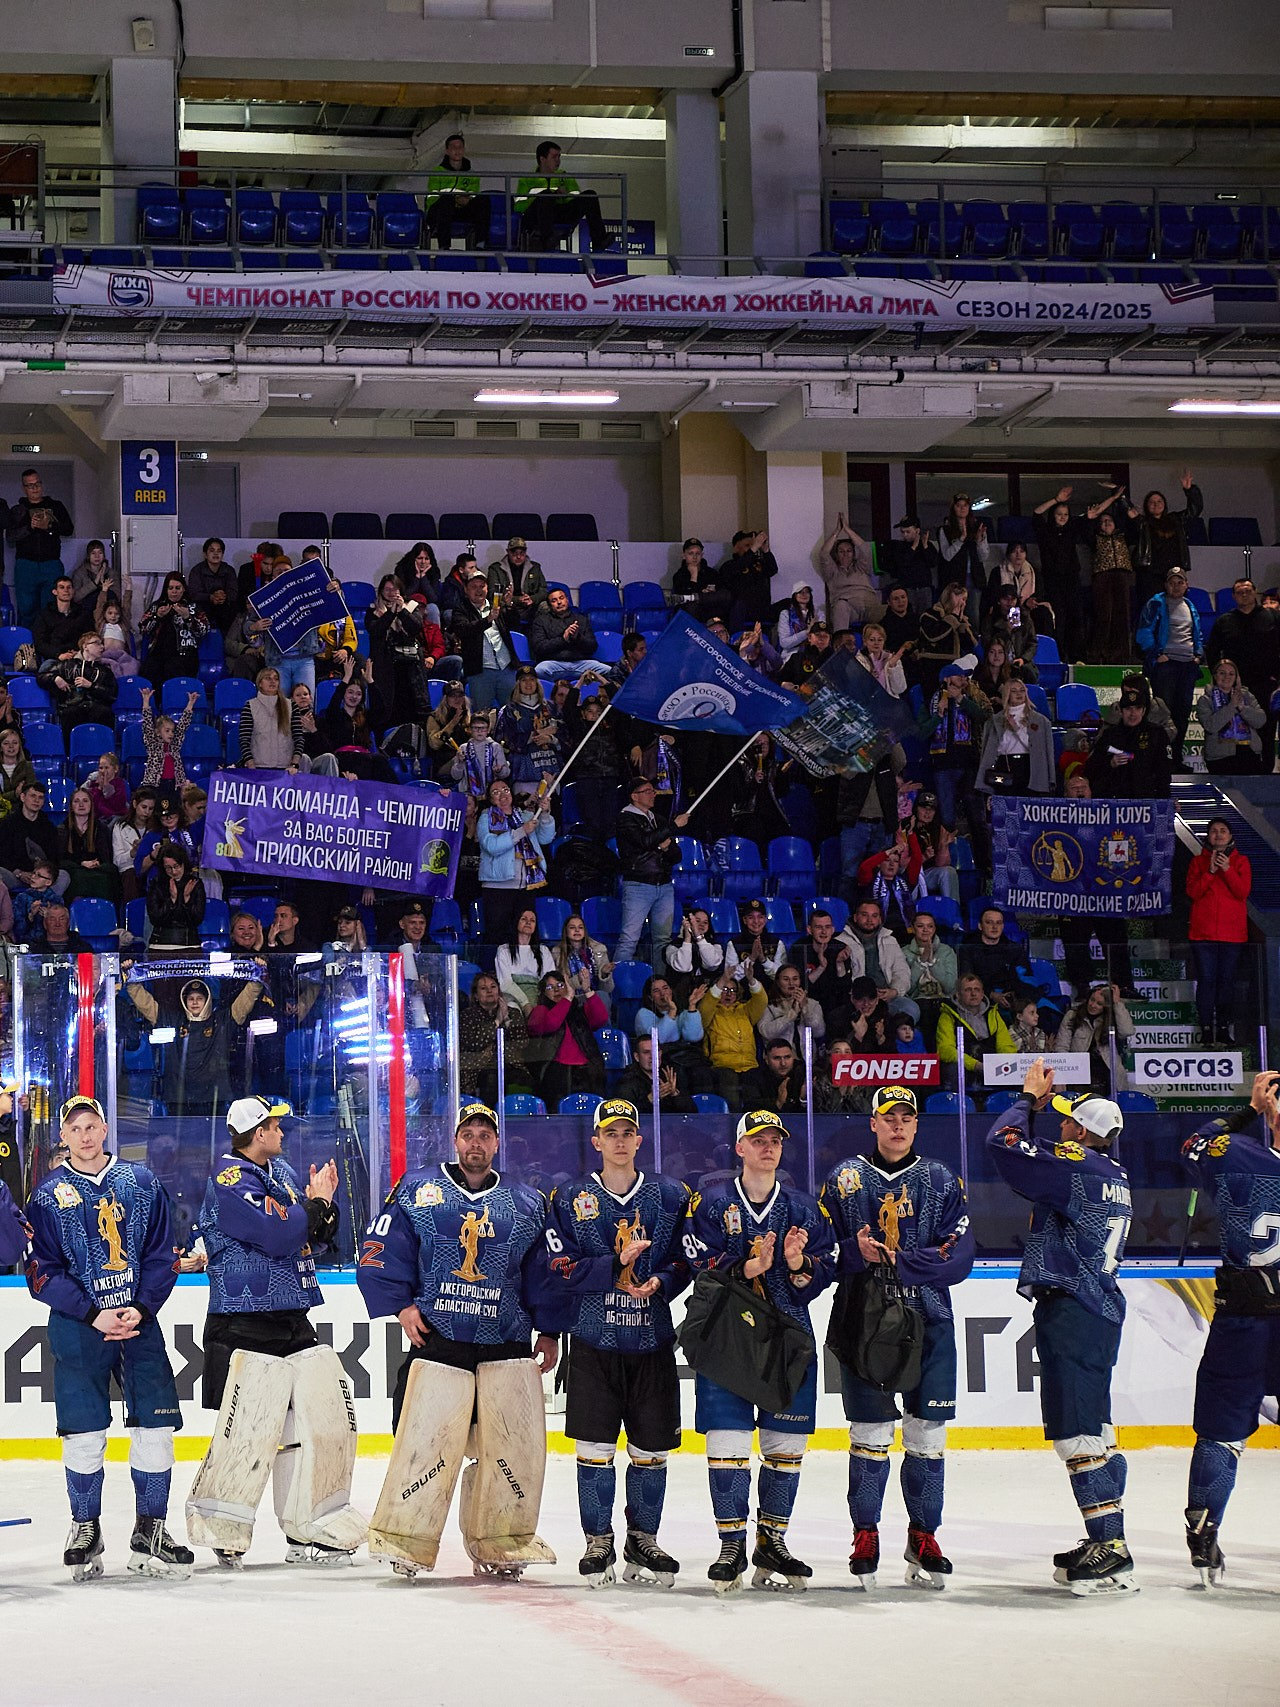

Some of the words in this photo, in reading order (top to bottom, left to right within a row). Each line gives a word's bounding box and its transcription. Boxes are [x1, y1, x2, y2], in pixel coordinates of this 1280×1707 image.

[113, 276, 147, 289] ЖХЛ
[186, 286, 336, 309] ЧЕМПИОНАТ
[342, 289, 441, 309] РОССИИ
[447, 291, 481, 309] ПО
[485, 291, 587, 312] ХОККЕЮ
[613, 293, 726, 313] ЖЕНСКАЯ
[732, 290, 871, 315] ХОККЕЙНАЯ
[878, 297, 940, 316] ЛИГА
[956, 299, 1031, 319] СЕЗОН
[1035, 301, 1152, 321] 2024/2025
[139, 448, 160, 484] 3
[135, 490, 166, 503] AREA
[684, 627, 744, 680] НИЖЕГОРОДСКОЕ
[745, 679, 792, 707] РЕГИОНАЛЬНОЕ
[714, 668, 753, 697] ОТДЕЛЕНИЕ
[213, 780, 267, 808] НАША
[272, 786, 360, 820] КОМАНДА
[378, 799, 462, 832] ЧЕМПИОН!
[1023, 804, 1110, 825] ХОККЕЙНЫЙ
[1116, 807, 1151, 824] КЛУБ
[283, 820, 302, 839] ЗА
[305, 823, 334, 843] ВАС
[336, 826, 392, 850] БОЛЕЕТ
[255, 840, 360, 873] ПРИОКСКИЙ
[364, 856, 412, 881] РАЙОН!
[1007, 889, 1123, 914] НИЖЕГОРОДСКИЕ
[1126, 891, 1163, 913] СУДЬИ
[1130, 1010, 1182, 1020] ЧИСТОТЫ
[1136, 1032, 1201, 1044] SYNERGETIC
[834, 1059, 938, 1080] FONBET
[682, 1233, 708, 1259] 84
[440, 1282, 501, 1301] ИЖЕГОРОДСКИЙ
[483, 1305, 497, 1318] СУД
